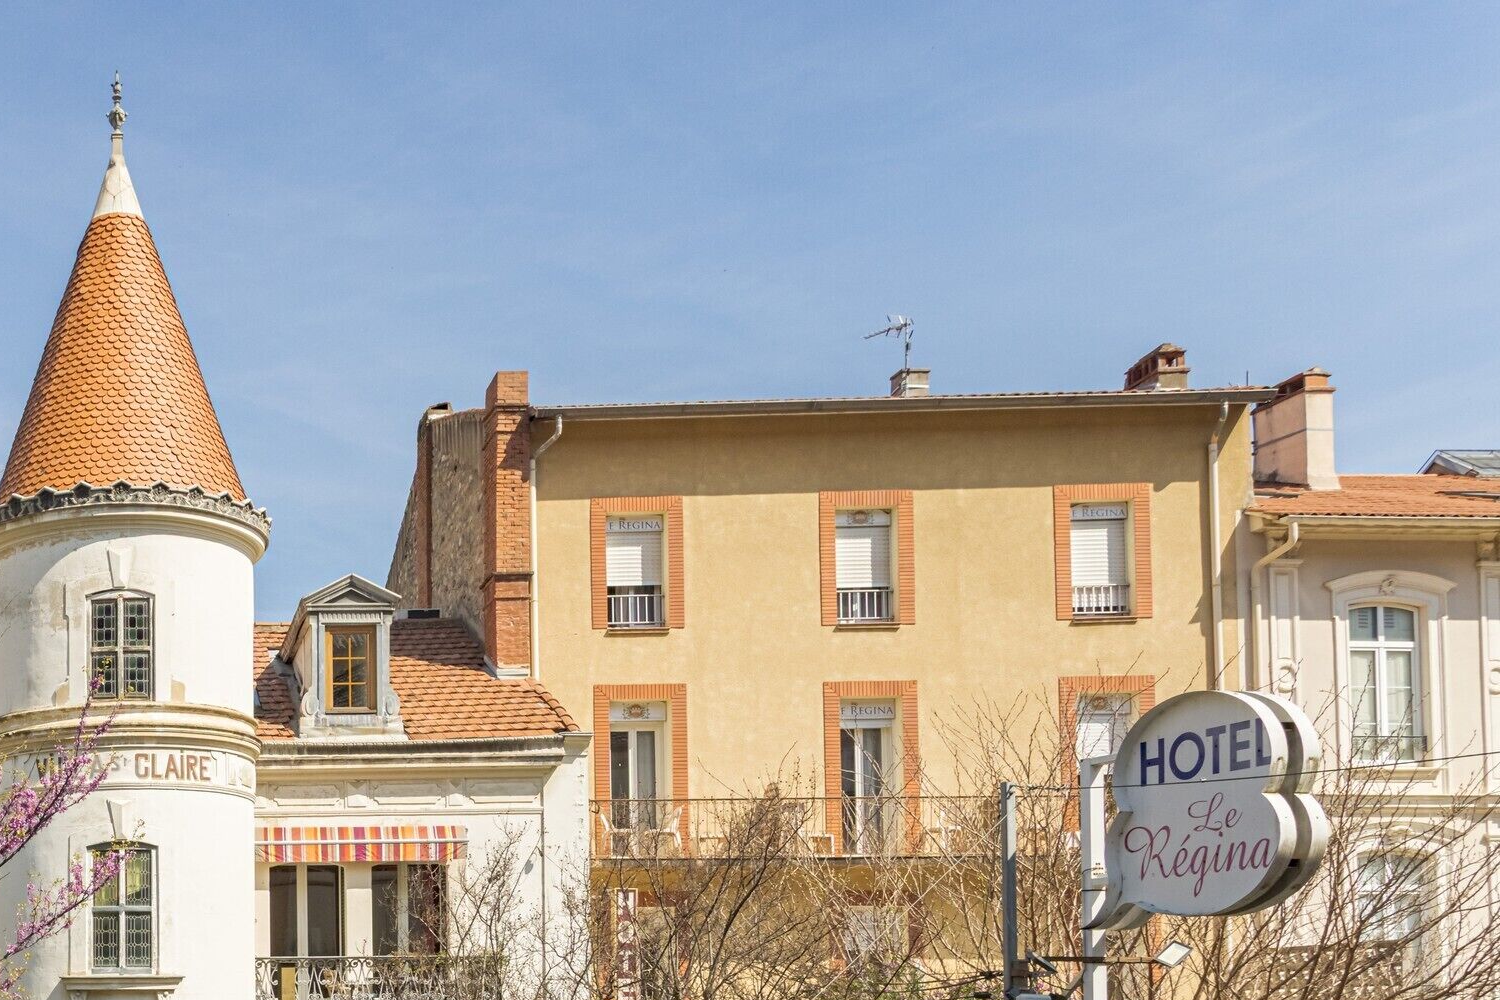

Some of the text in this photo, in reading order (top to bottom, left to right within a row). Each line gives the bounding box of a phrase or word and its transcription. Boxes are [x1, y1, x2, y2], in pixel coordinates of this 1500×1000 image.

[618, 520, 661, 530] REGINA
[1082, 508, 1126, 518] REGINA
[850, 705, 894, 715] REGINA
[1139, 717, 1272, 787] HOTEL
[1187, 791, 1243, 832] Le
[1123, 825, 1277, 898] Régina
